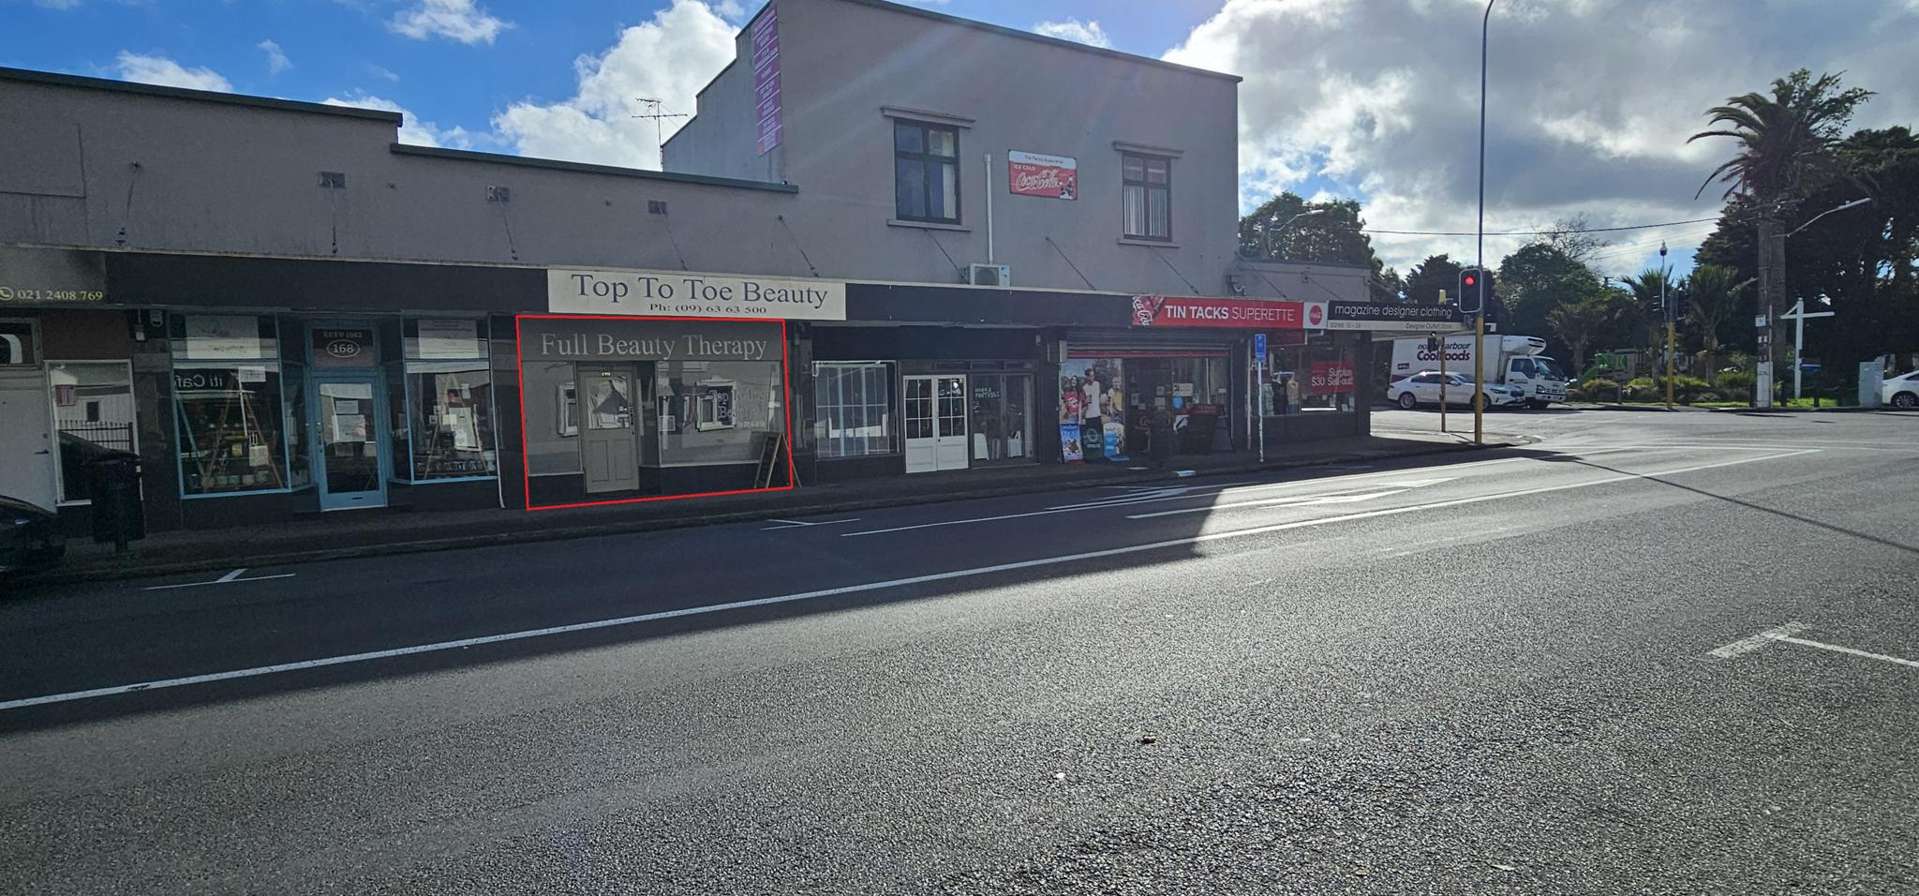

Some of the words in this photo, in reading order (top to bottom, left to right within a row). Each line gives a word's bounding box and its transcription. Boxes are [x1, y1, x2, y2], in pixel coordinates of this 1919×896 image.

[17, 289, 41, 300] 021
[46, 290, 77, 300] 2408
[80, 290, 103, 300] 769
[571, 273, 628, 302] Top
[638, 277, 674, 299] To
[683, 279, 733, 301] Toe
[744, 281, 828, 309] Beauty
[650, 303, 671, 312] Ph:
[675, 304, 702, 313] (09)
[706, 305, 723, 313] 63
[725, 305, 740, 313] 63
[1165, 305, 1187, 319] TIN
[1189, 305, 1229, 319] TACKS
[1231, 306, 1295, 321] SUPERETTE
[1334, 304, 1381, 318] magazine
[1382, 304, 1419, 319] designer
[1420, 306, 1453, 319] clothing
[333, 343, 354, 353] 168
[541, 333, 589, 356] Full
[598, 333, 676, 361] Beauty
[683, 334, 767, 361] Therapy
[1443, 342, 1472, 350] arbour
[1417, 350, 1471, 361] Cooloods
[1311, 376, 1325, 387] $30
